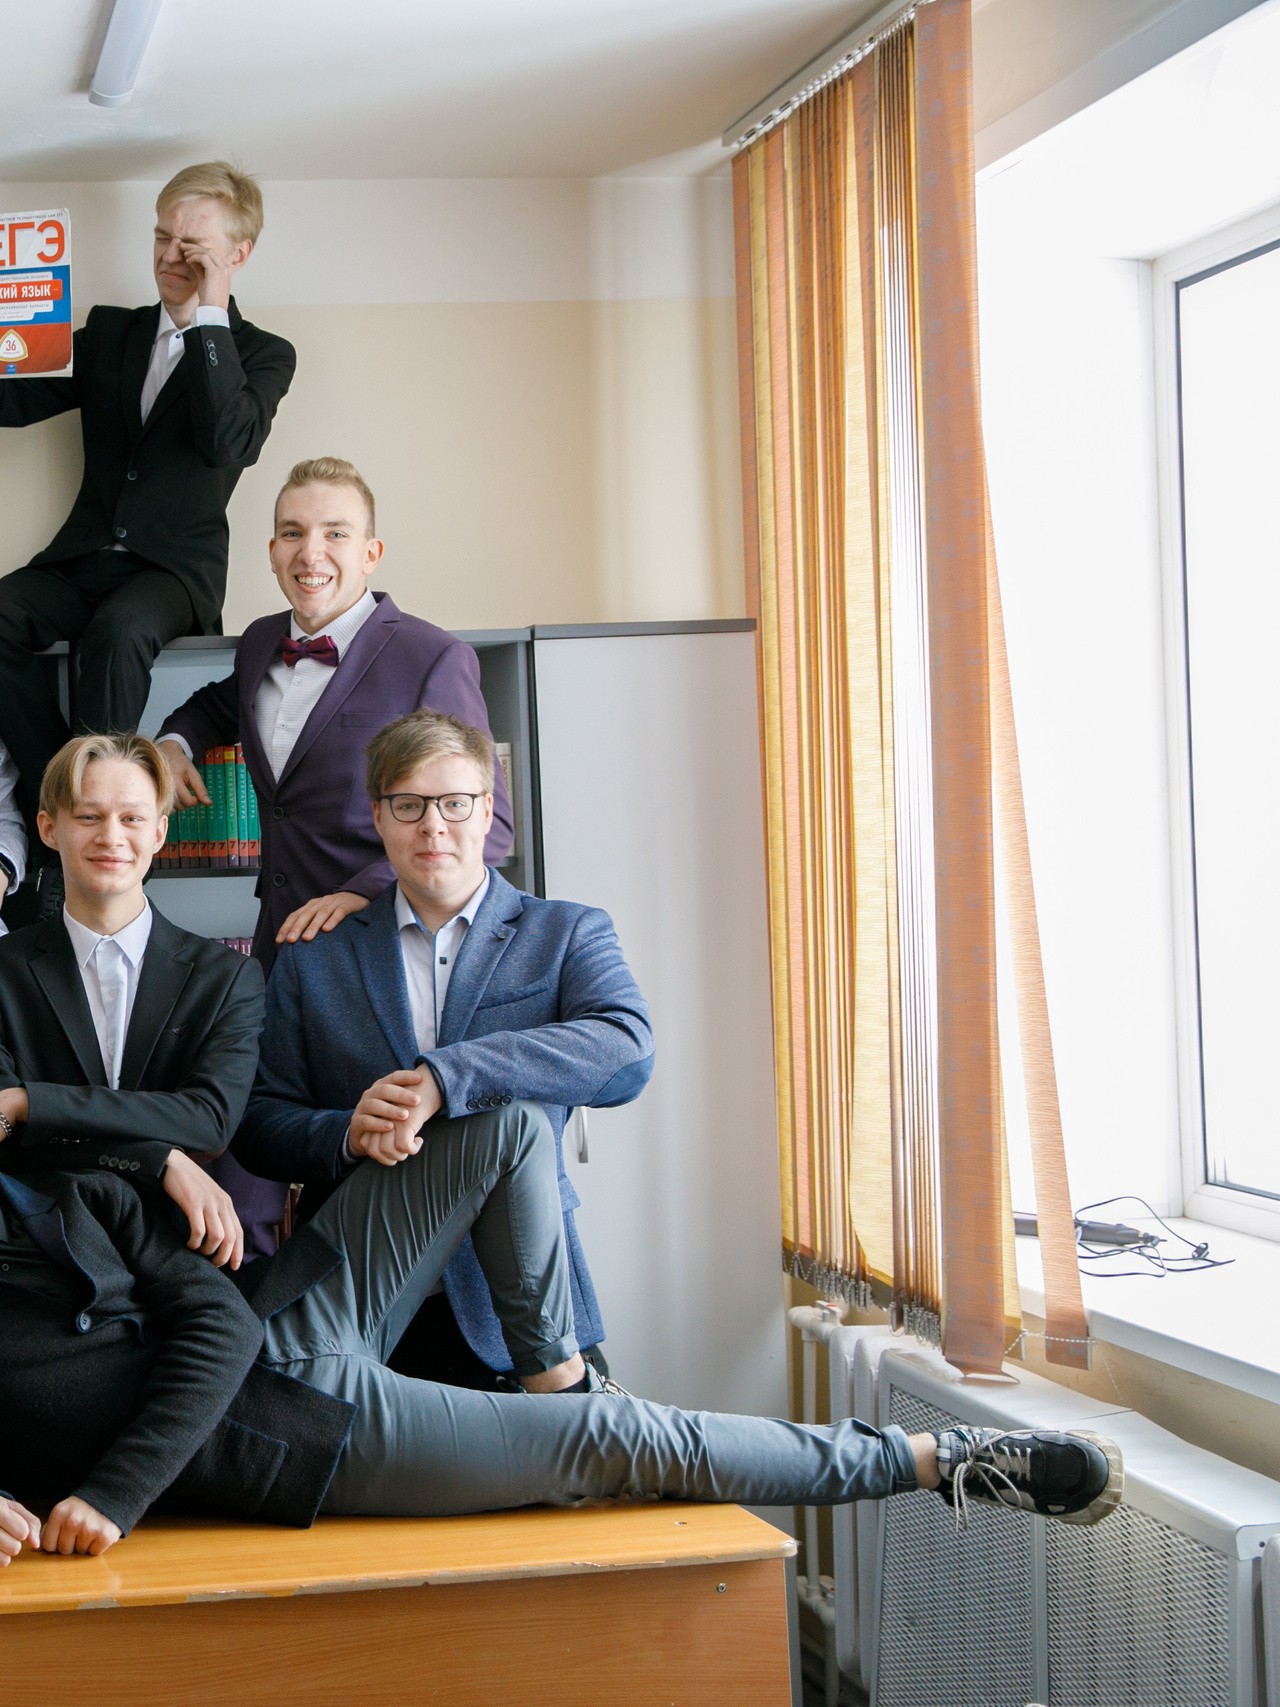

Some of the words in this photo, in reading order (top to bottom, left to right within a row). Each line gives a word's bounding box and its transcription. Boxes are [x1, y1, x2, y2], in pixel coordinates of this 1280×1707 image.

[22, 284, 51, 298] ЯЗЫК
[6, 340, 16, 351] 36
[201, 842, 207, 850] 7
